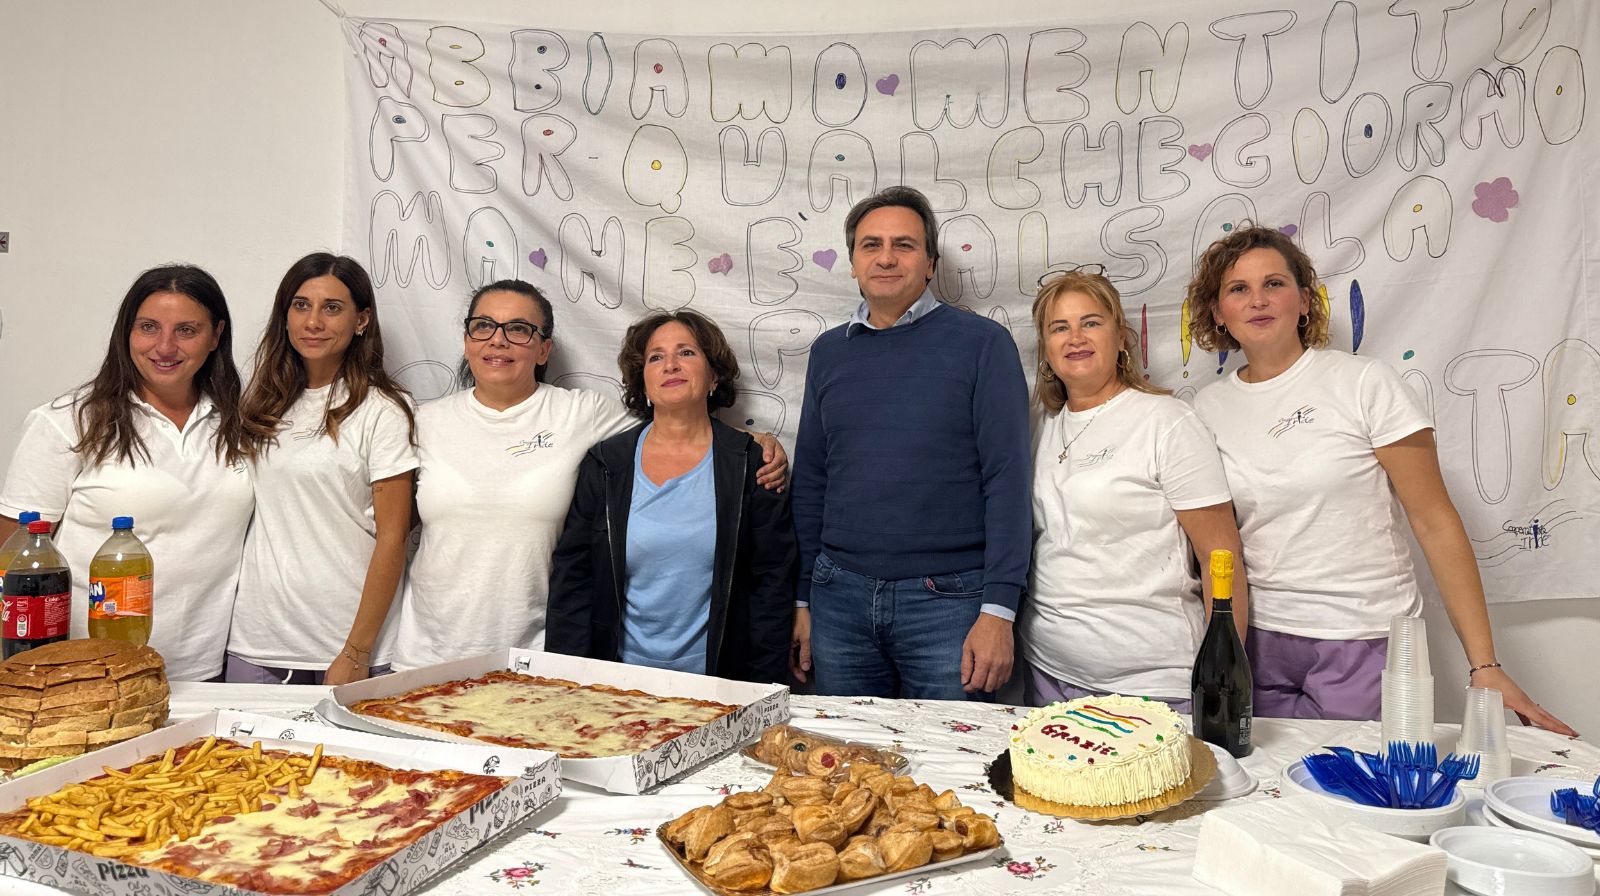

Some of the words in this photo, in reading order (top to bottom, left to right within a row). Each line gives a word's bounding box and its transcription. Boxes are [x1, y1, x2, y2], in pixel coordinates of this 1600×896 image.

[357, 21, 869, 128] ABBIAMO
[369, 95, 578, 202] PER
[622, 115, 1191, 214] QUALCHE
[369, 189, 518, 291] MA
[1298, 174, 1454, 279] LA
[524, 776, 546, 793] PIZZA
